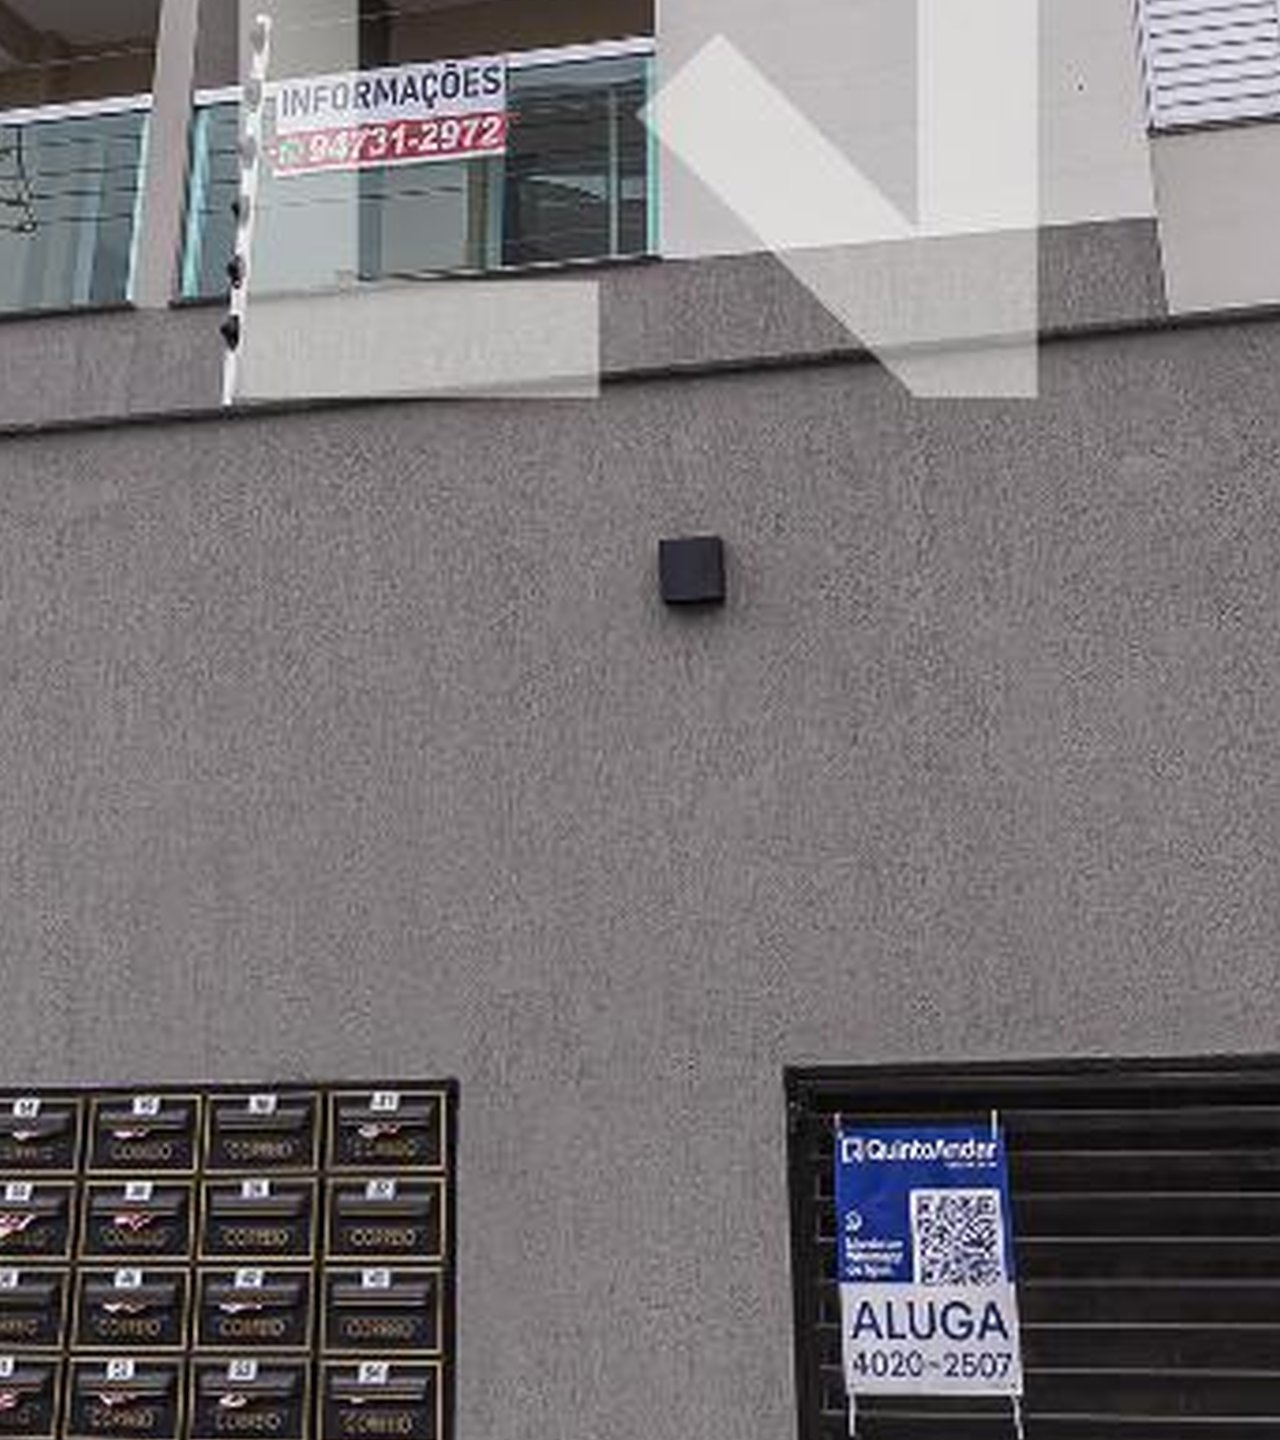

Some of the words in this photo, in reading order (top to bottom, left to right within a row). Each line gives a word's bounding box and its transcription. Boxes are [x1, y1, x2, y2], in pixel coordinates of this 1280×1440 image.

[281, 63, 503, 117] INFORMAÇÕES
[851, 1300, 1010, 1341] ALUGA
[852, 1349, 1013, 1378] 4020-2507
